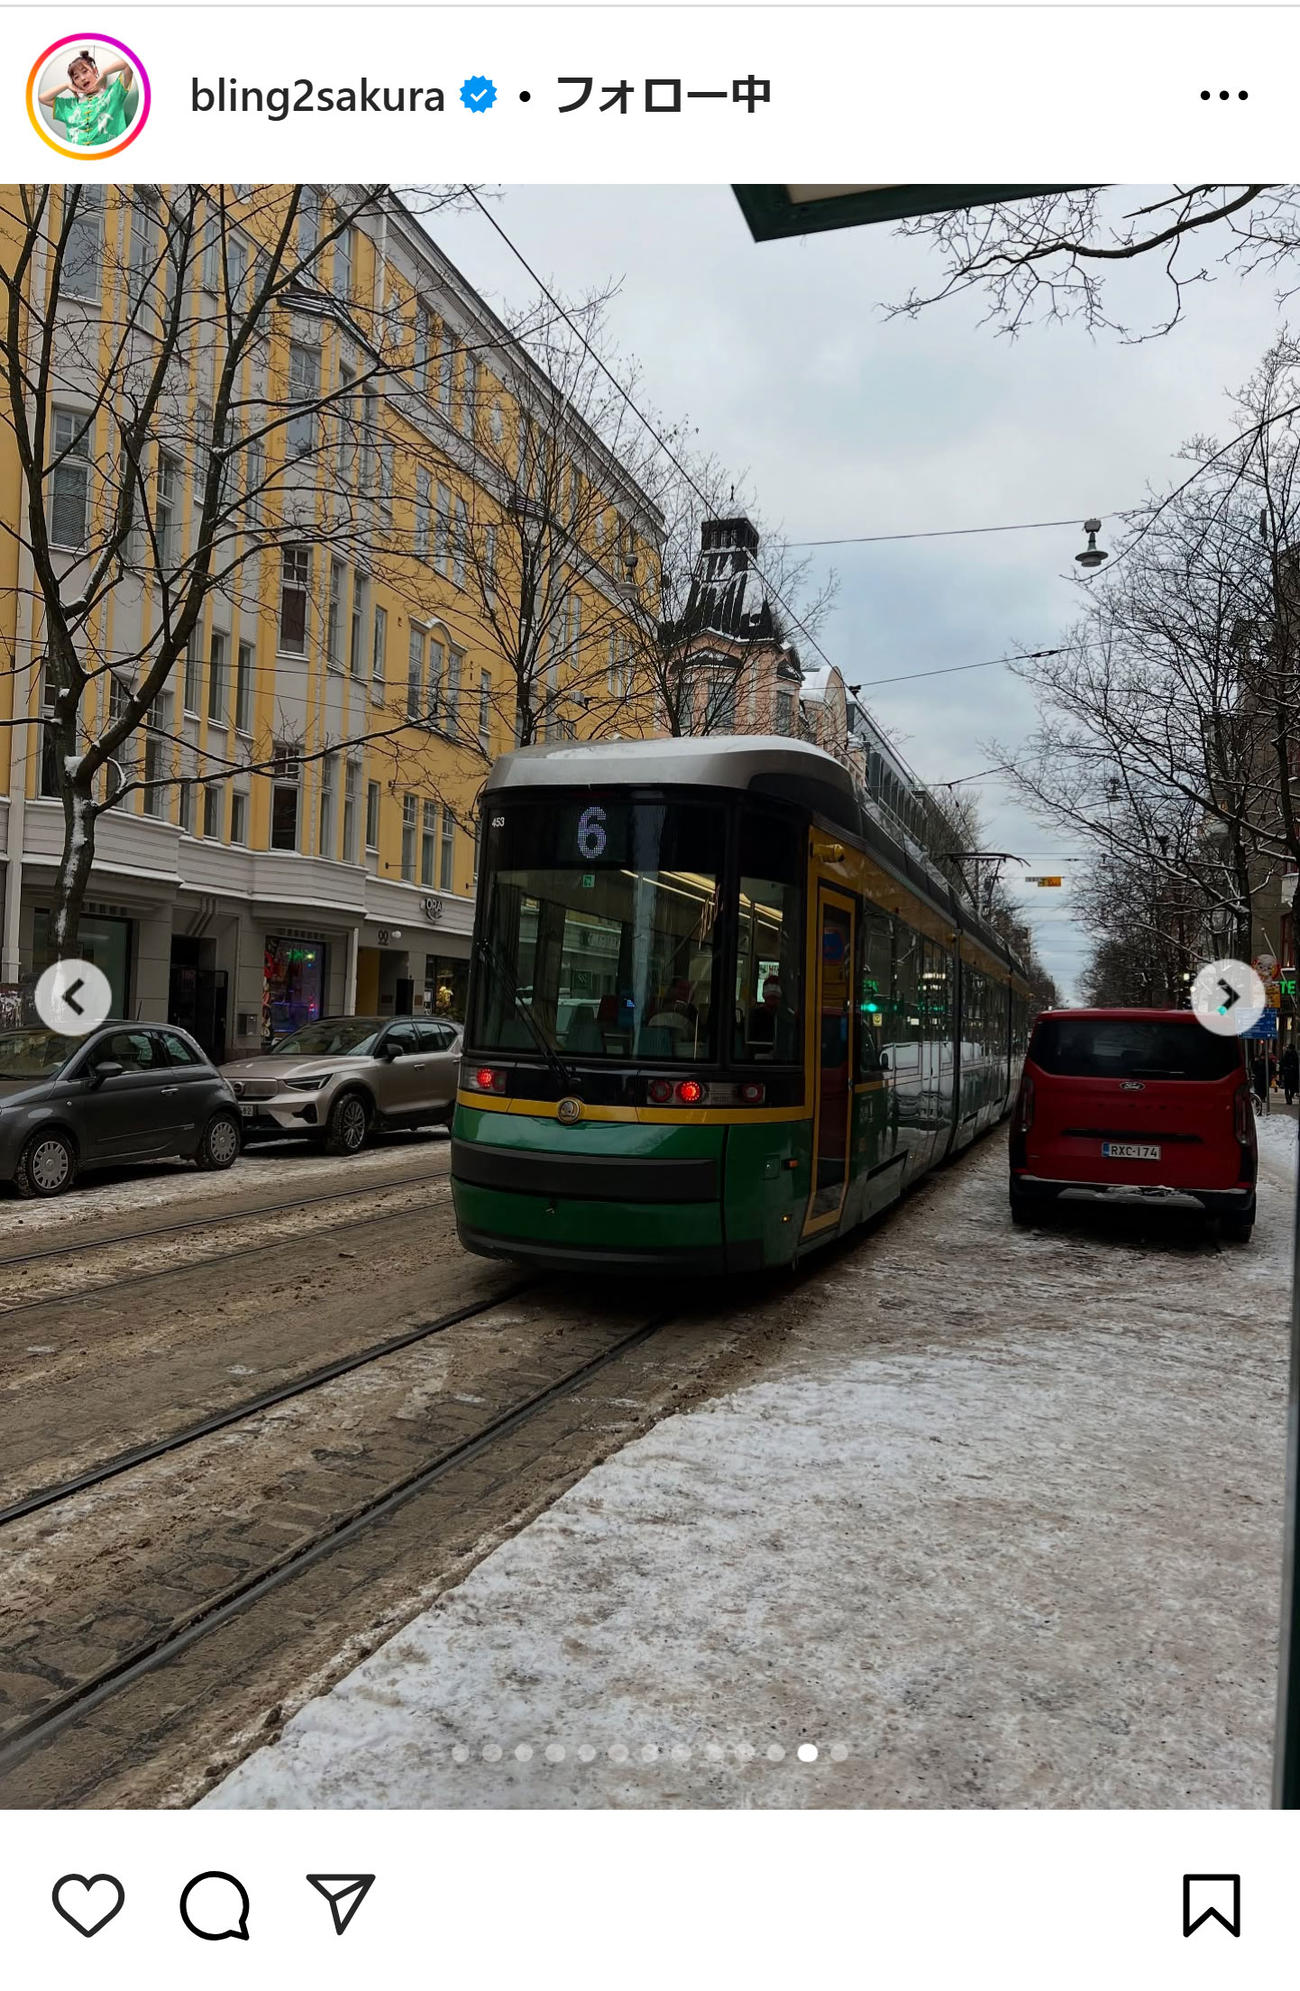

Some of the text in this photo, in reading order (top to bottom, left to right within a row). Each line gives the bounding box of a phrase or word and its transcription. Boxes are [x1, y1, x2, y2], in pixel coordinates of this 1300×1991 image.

[491, 816, 505, 828] 453
[577, 806, 607, 859] 6
[1111, 1145, 1158, 1158] RXC-174
